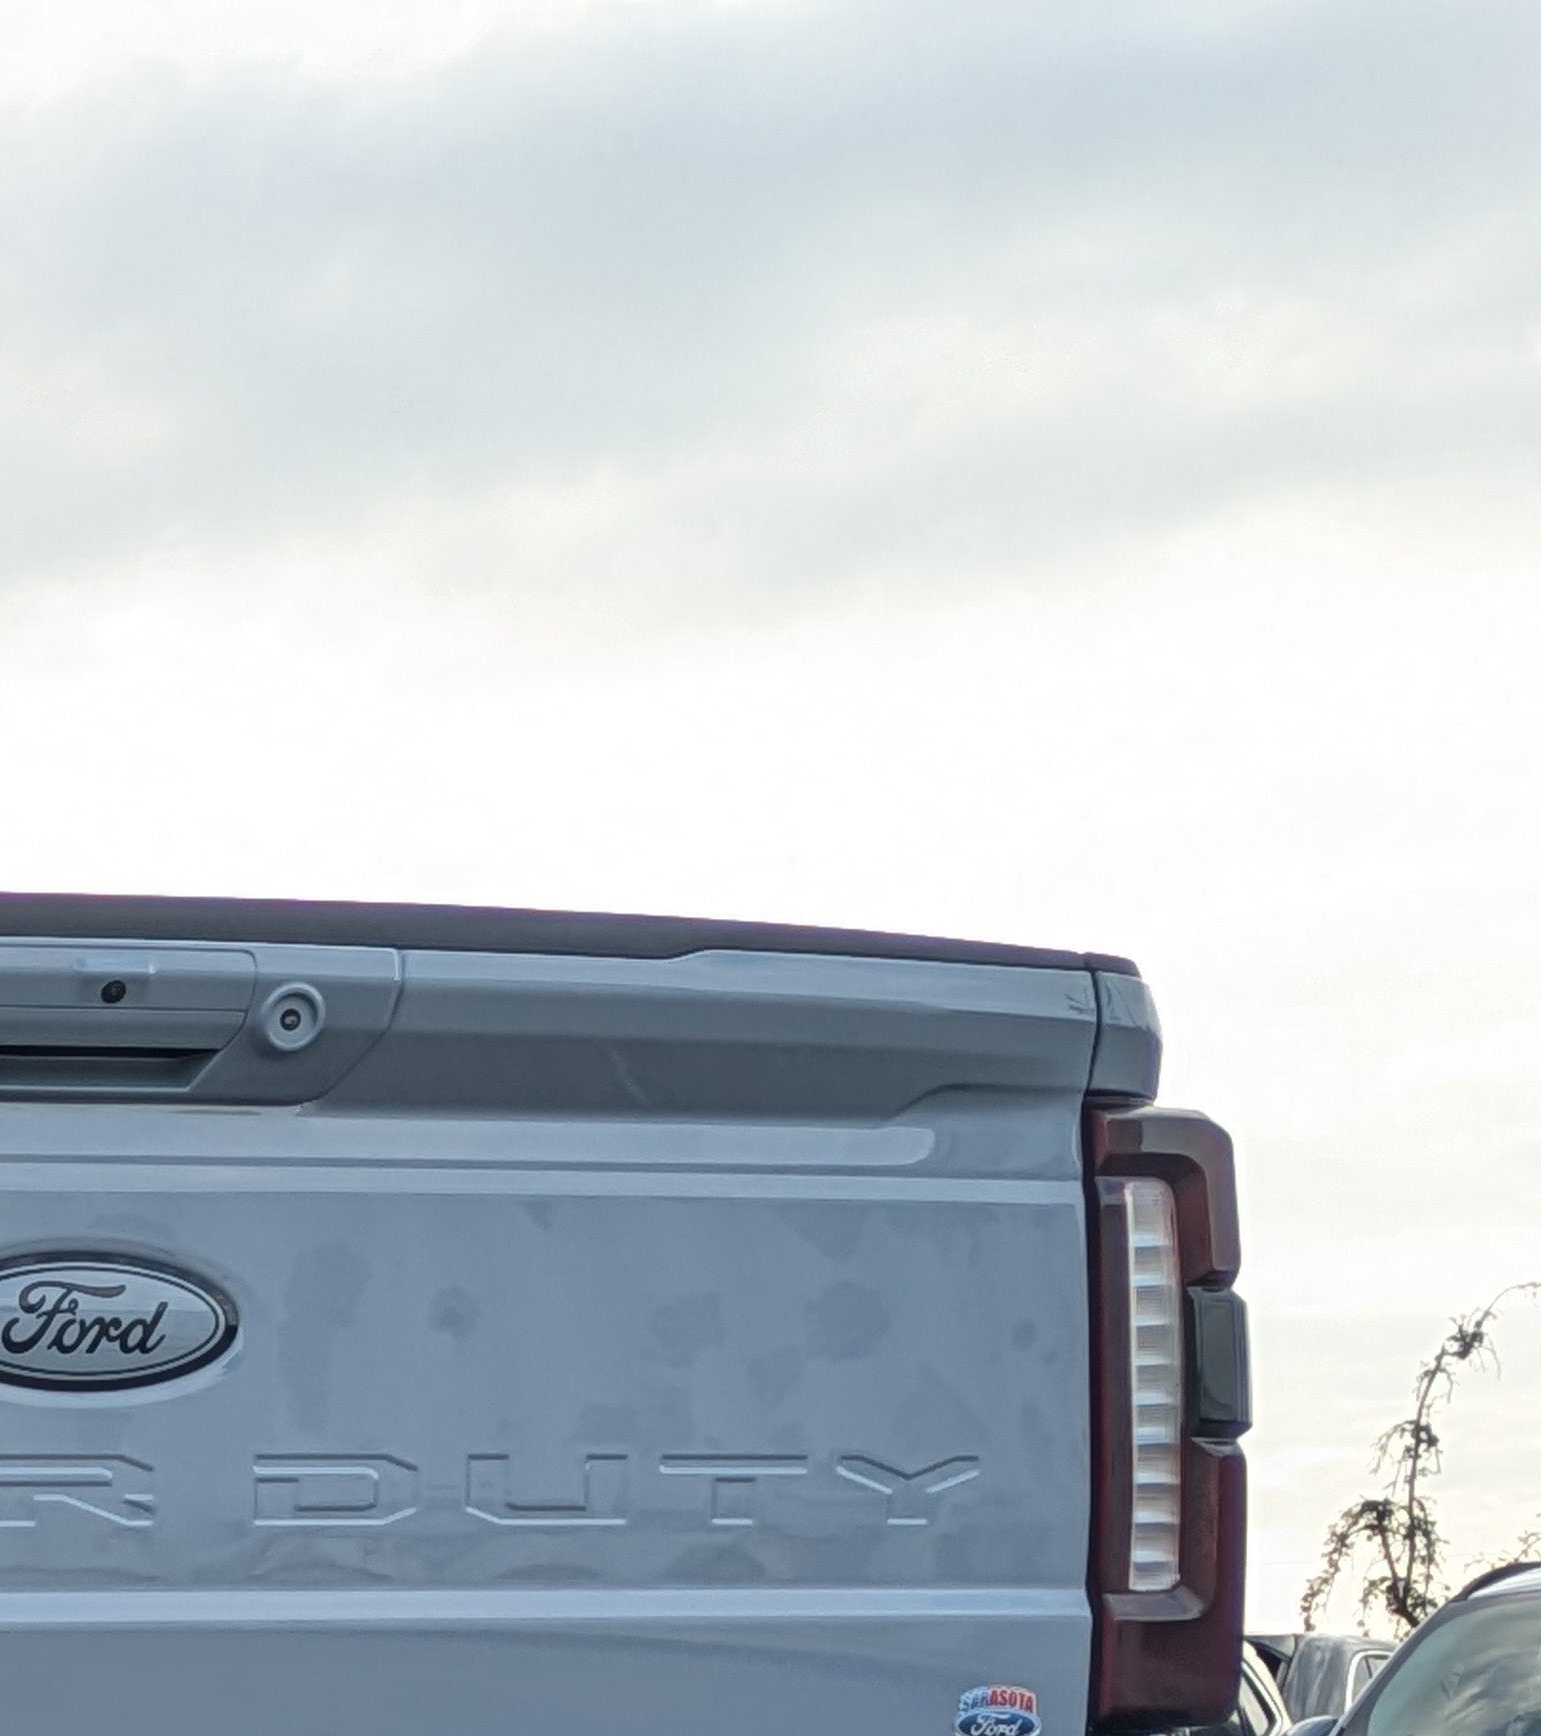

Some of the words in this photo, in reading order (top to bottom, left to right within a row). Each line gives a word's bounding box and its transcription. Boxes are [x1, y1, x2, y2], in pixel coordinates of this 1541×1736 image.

[1, 1279, 169, 1354] Ford
[253, 1453, 980, 1526] DUTY
[970, 1713, 1023, 1736] Ford
